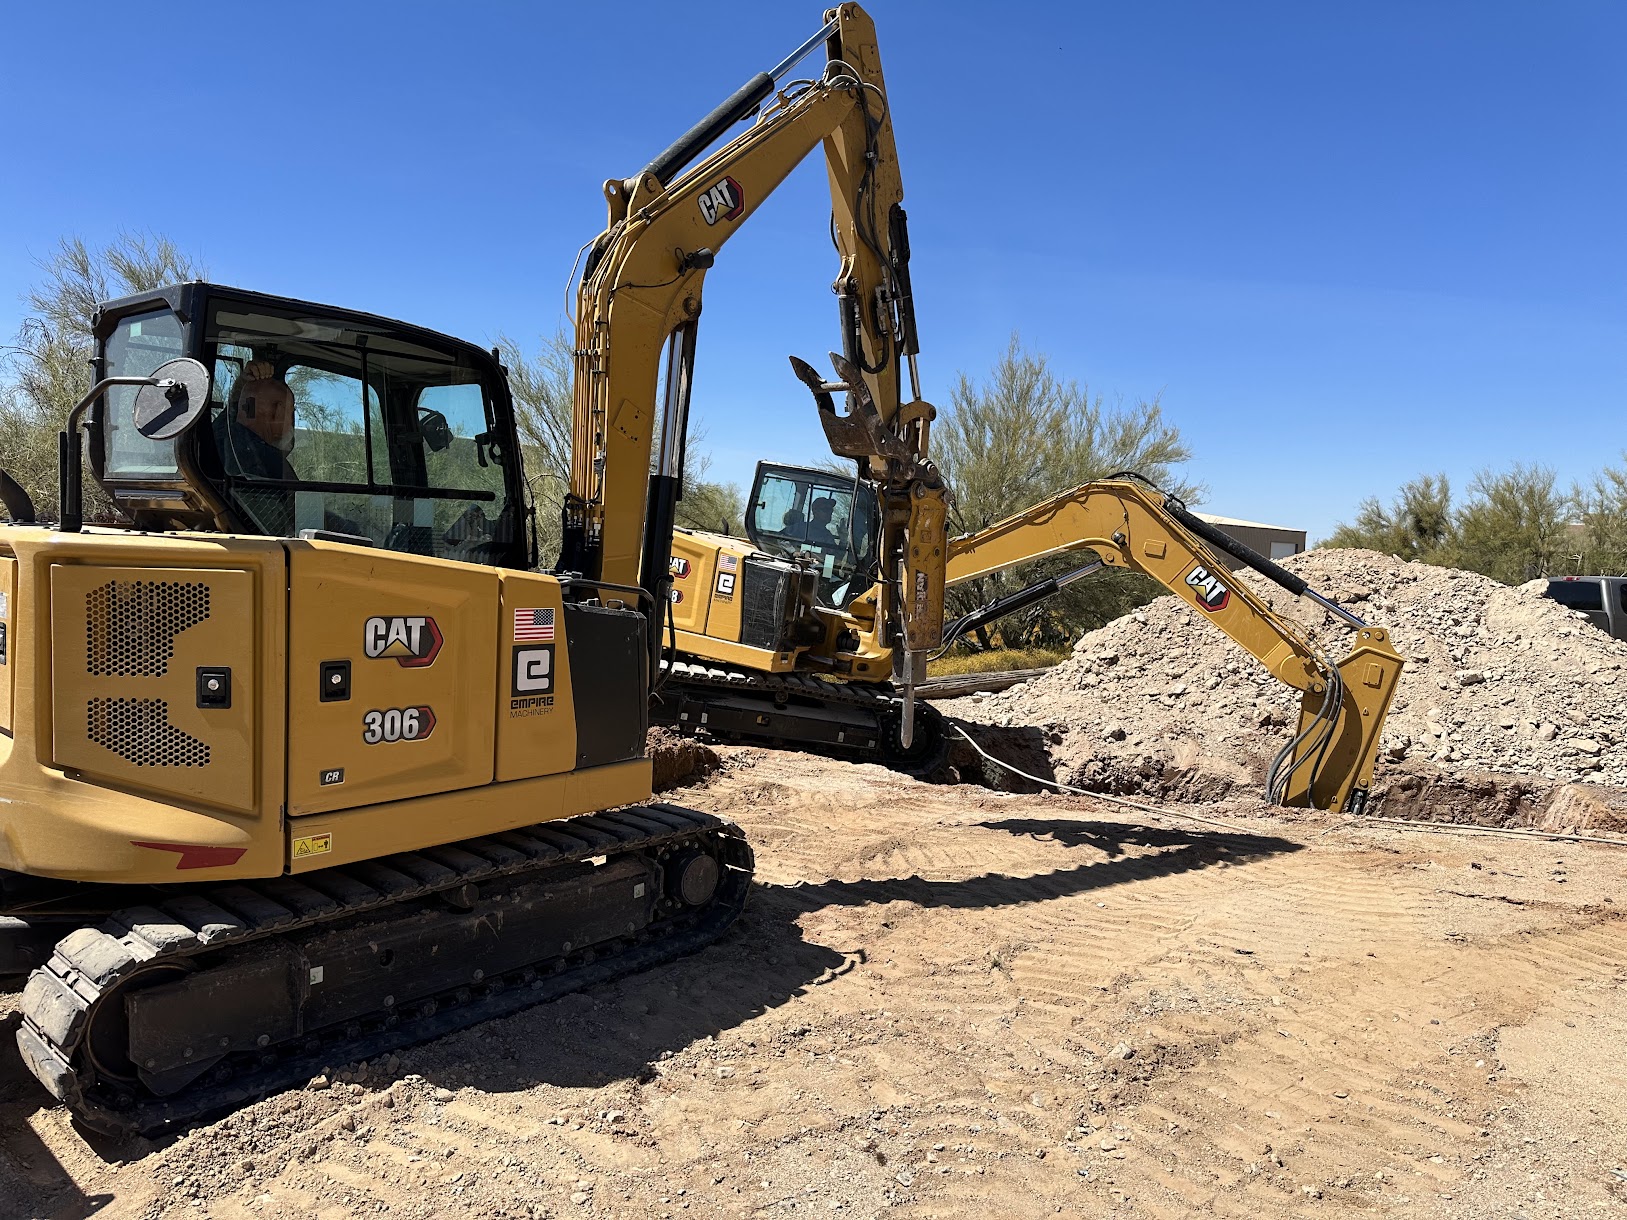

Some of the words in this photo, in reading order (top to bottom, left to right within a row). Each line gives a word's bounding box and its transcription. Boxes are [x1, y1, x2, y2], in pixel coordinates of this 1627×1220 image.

[698, 178, 735, 225] CAT
[1185, 566, 1228, 603] CAT
[365, 617, 426, 658] CAT
[509, 706, 554, 719] MACHINERY
[510, 696, 554, 710] EMPIRE
[364, 707, 420, 743] 306
[325, 771, 340, 783] CR
